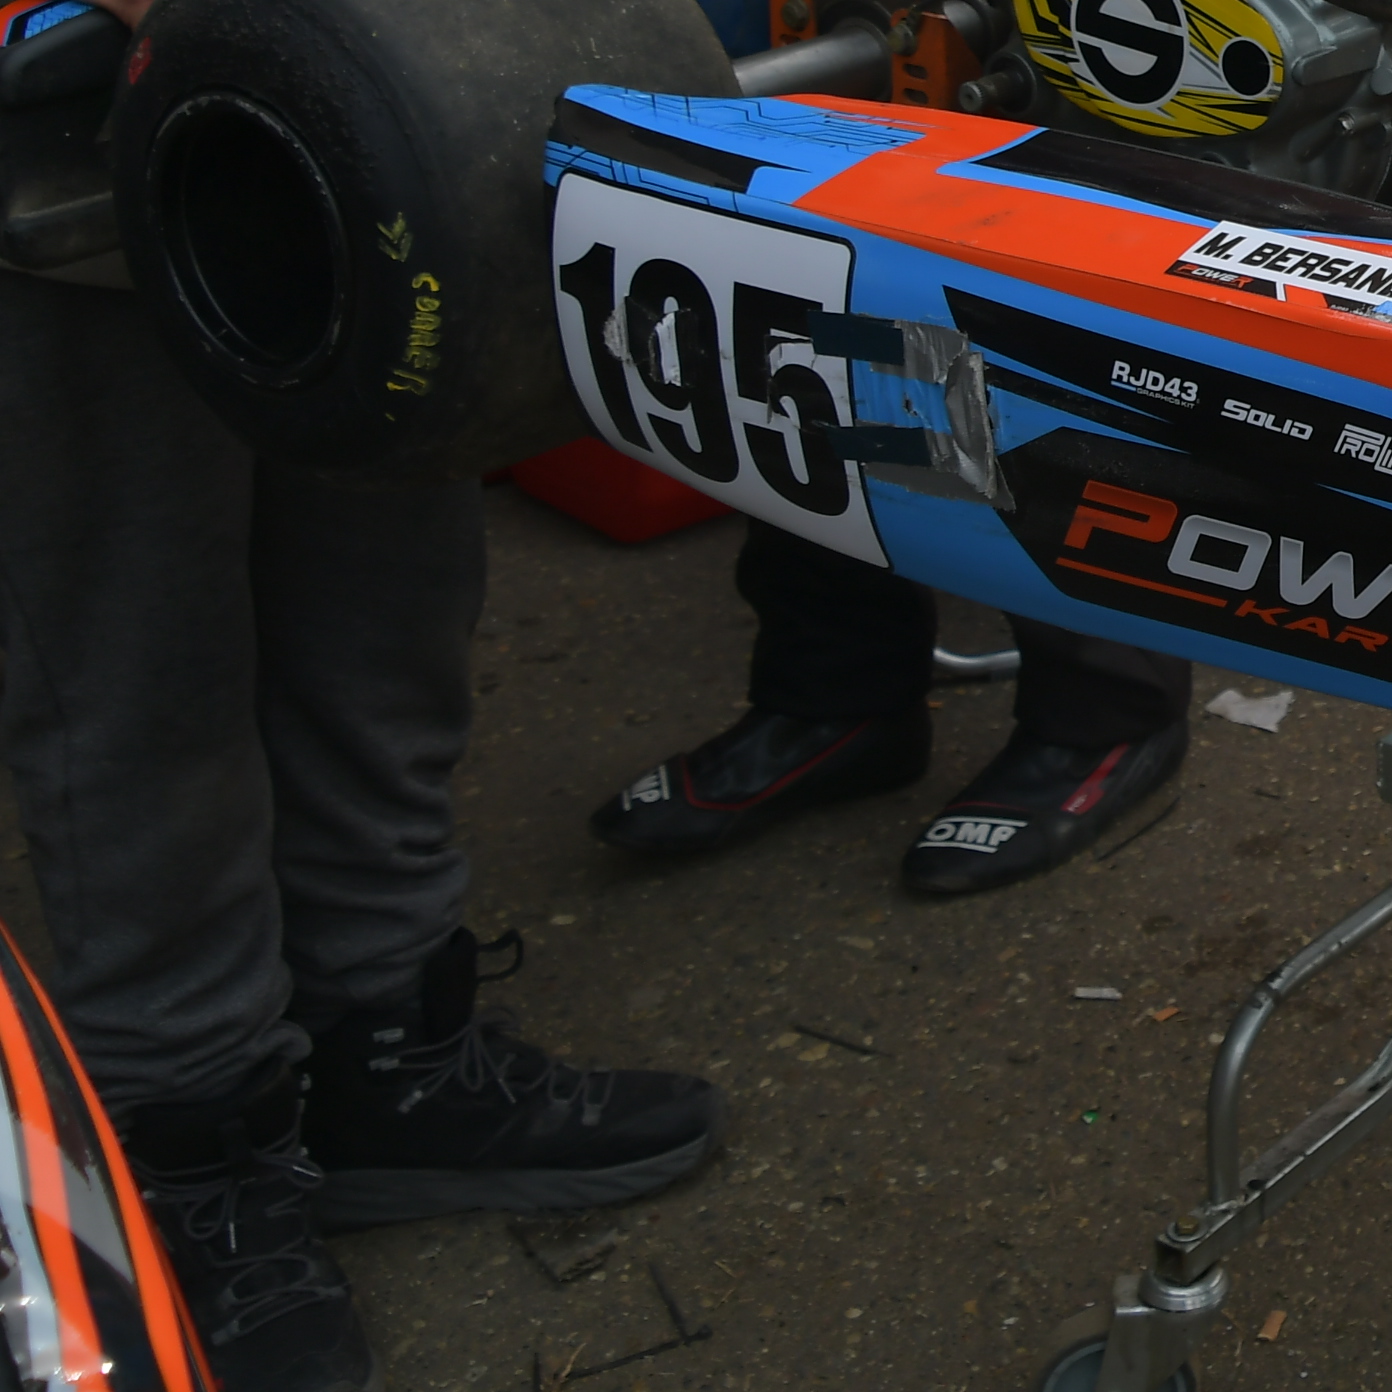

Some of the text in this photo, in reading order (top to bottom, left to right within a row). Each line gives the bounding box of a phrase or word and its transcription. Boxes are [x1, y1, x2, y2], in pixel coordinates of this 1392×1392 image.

[1195, 231, 1246, 262] M.
[560, 240, 852, 518] 195
[1111, 360, 1200, 403] RJD43
[924, 820, 1019, 848] OMP
